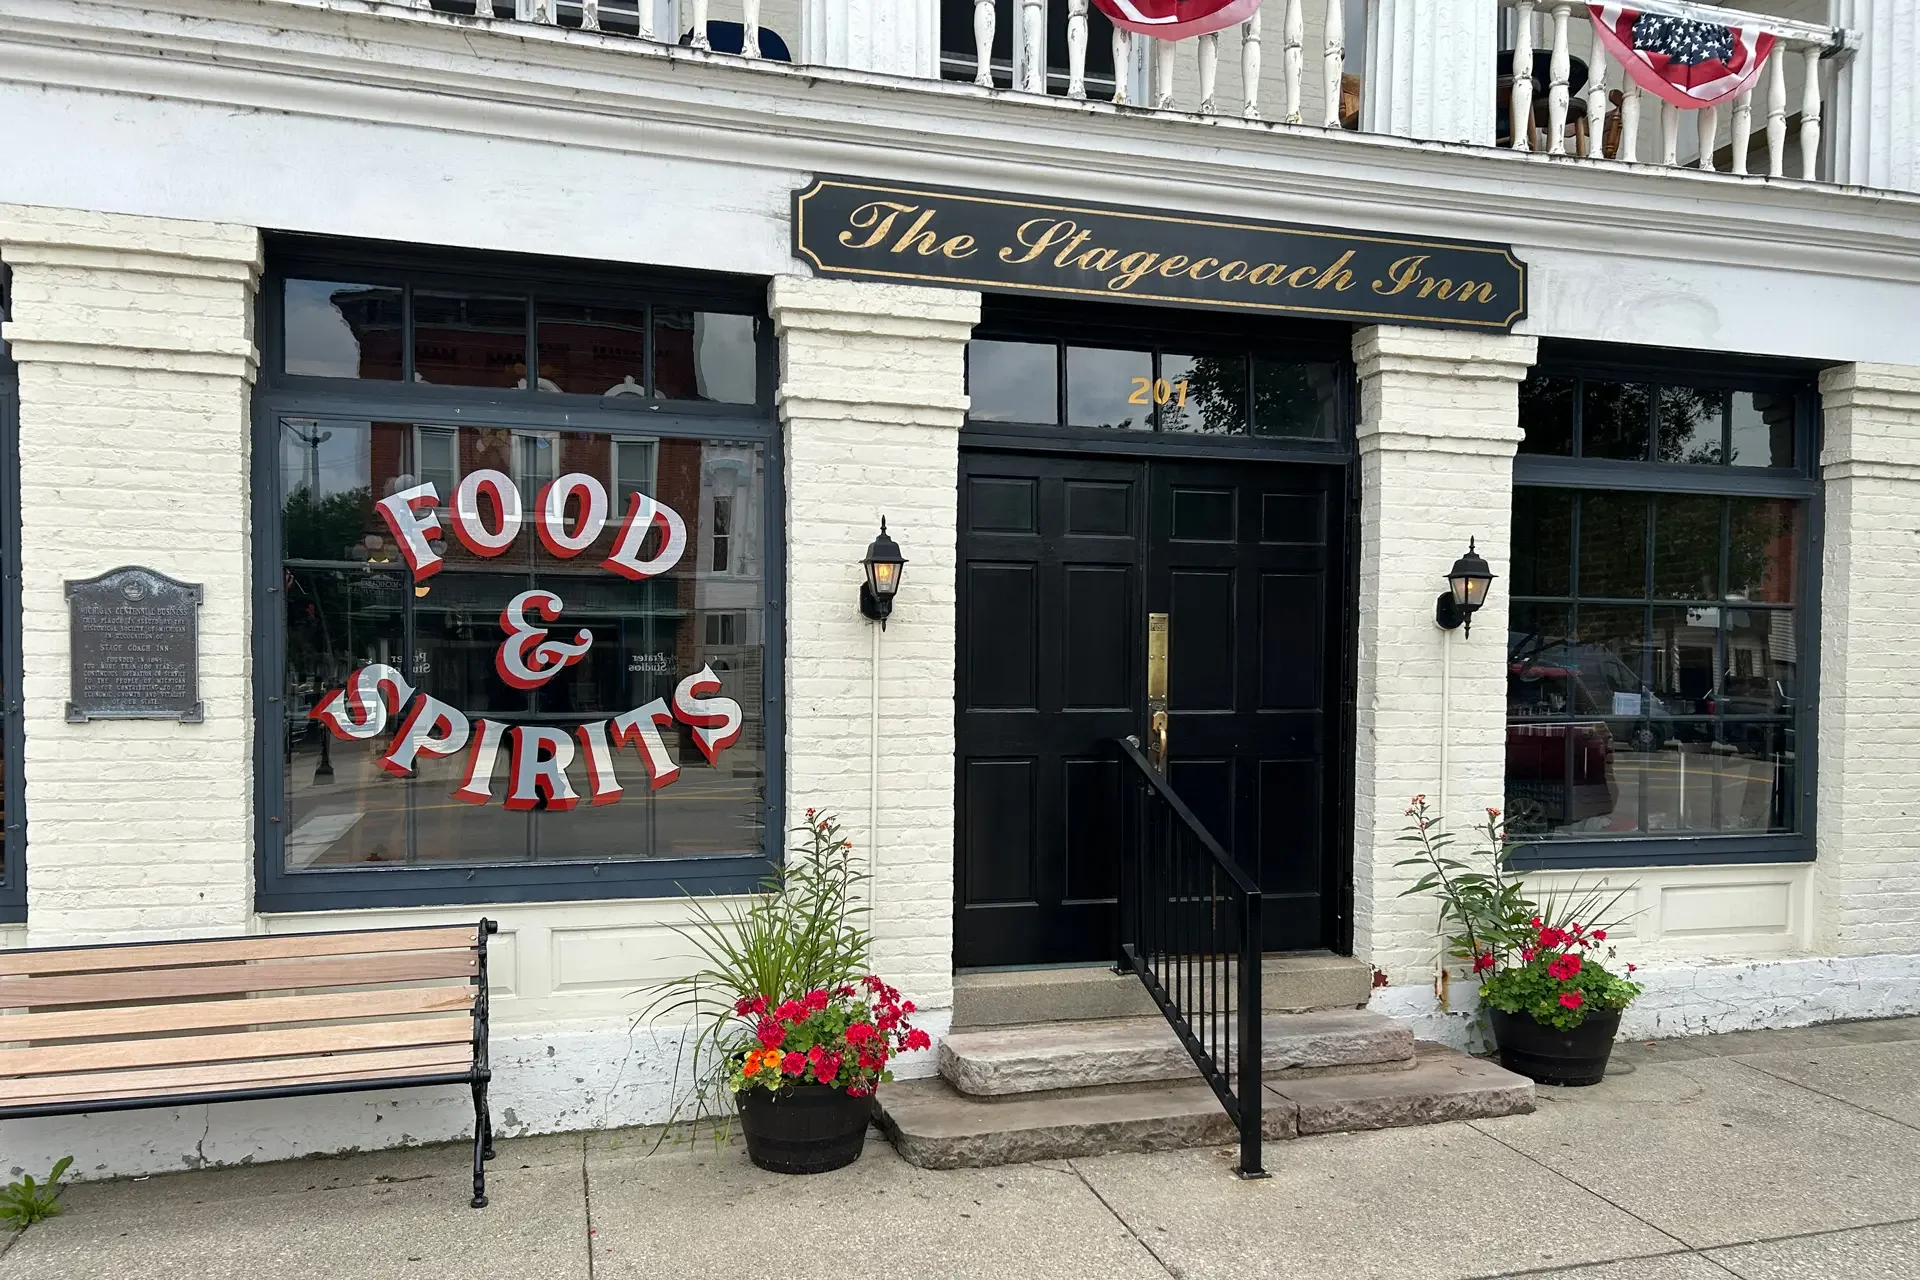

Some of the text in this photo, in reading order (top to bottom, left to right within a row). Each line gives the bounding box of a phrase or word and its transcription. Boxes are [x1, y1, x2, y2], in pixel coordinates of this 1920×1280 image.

[838, 201, 1498, 304] The Stagecoach Inn
[1127, 376, 1189, 409] 201
[375, 468, 687, 582] FOOD
[81, 607, 188, 615] MICHIGAN CENTENNIAL BUSINESS
[100, 644, 169, 652] STAGE COACH INN
[494, 589, 594, 691] &
[307, 661, 744, 812] SPIRITS
